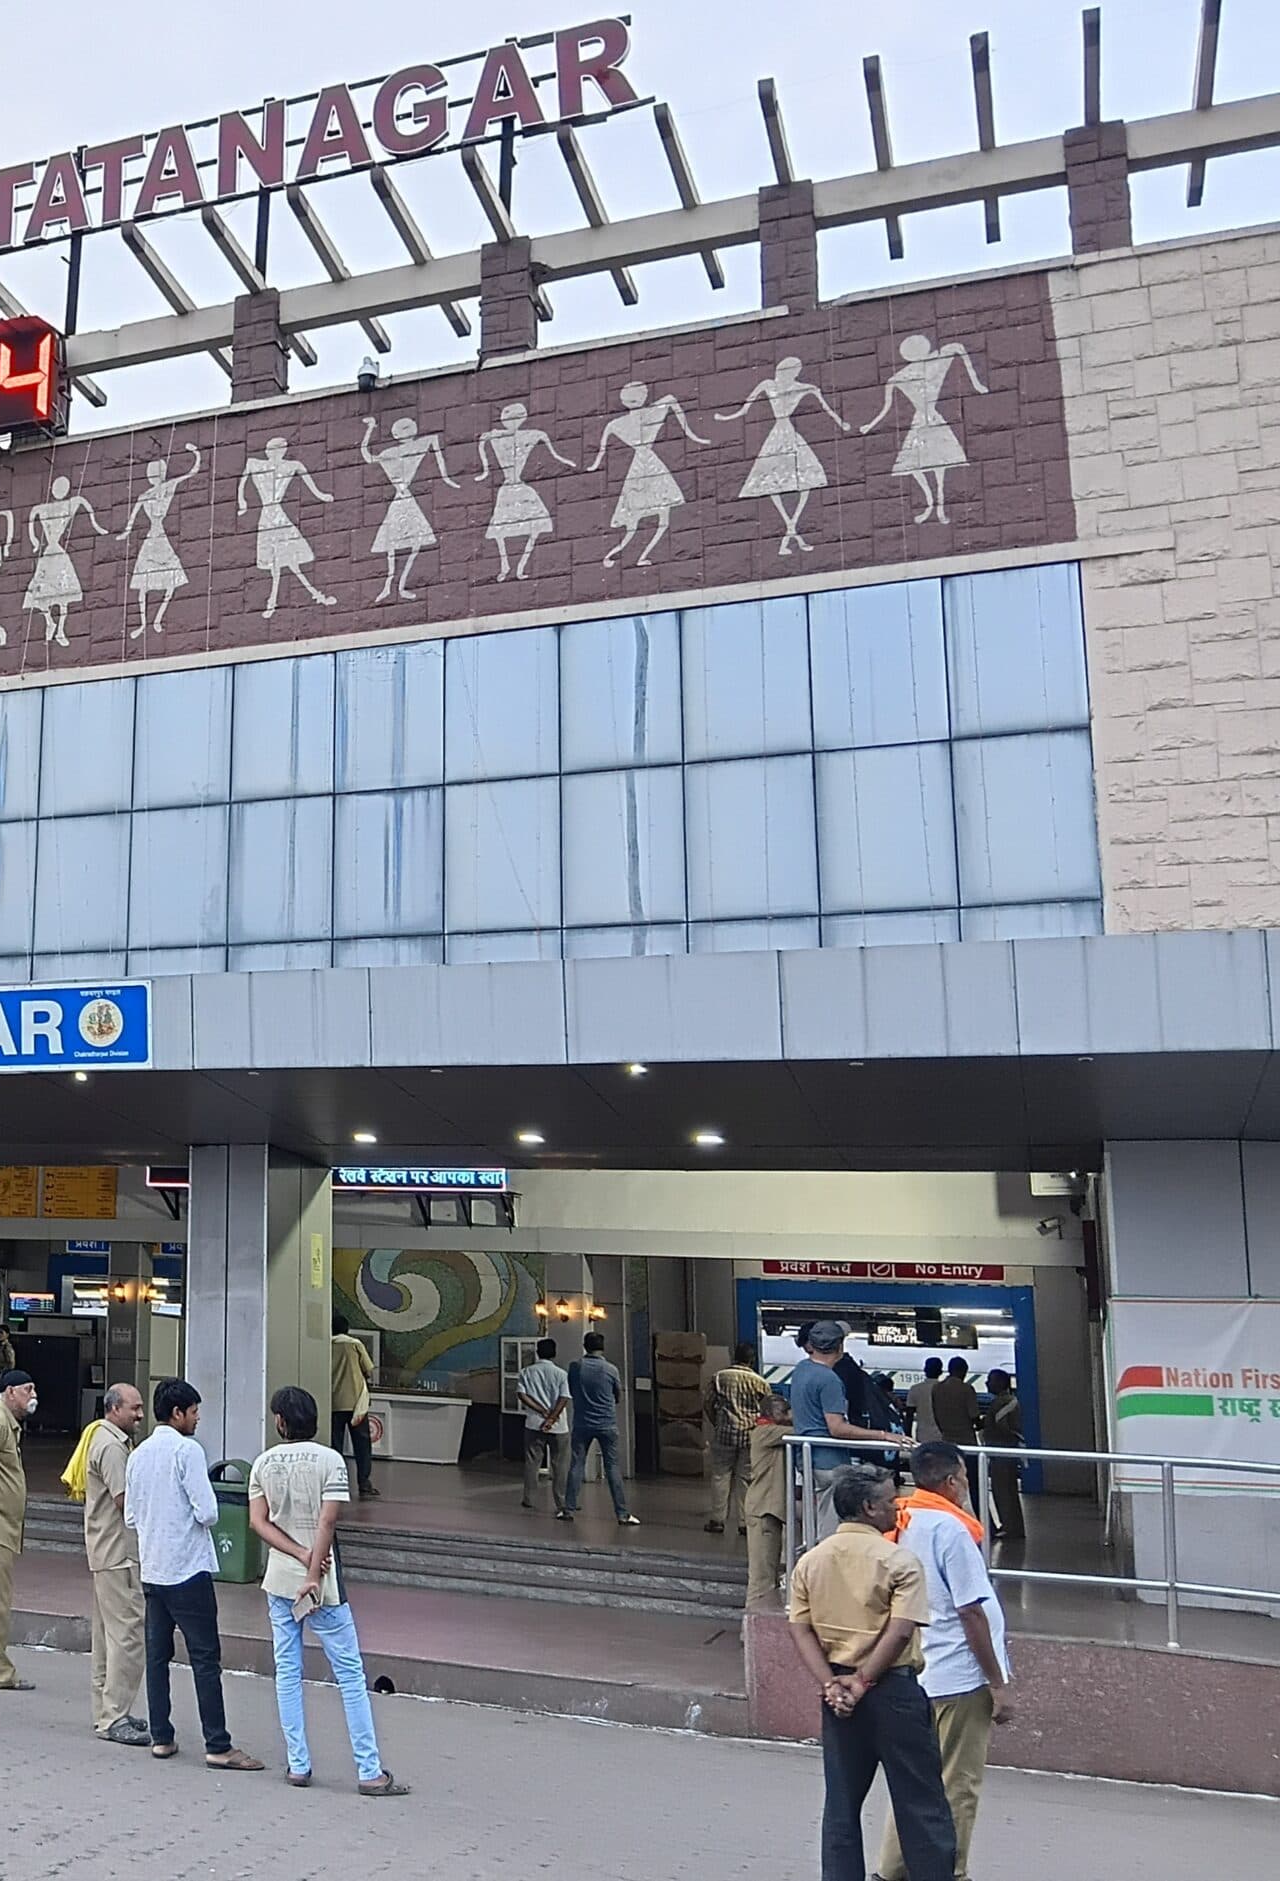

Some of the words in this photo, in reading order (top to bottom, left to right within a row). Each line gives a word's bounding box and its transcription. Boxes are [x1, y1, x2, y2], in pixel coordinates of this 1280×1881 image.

[410, 1170, 429, 1184] पर
[430, 1171, 475, 1185] आपका
[914, 1264, 936, 1275] No
[941, 1265, 983, 1278] Entry
[1166, 1367, 1233, 1389] Nation
[1217, 1397, 1262, 1423] राष्ट्र
